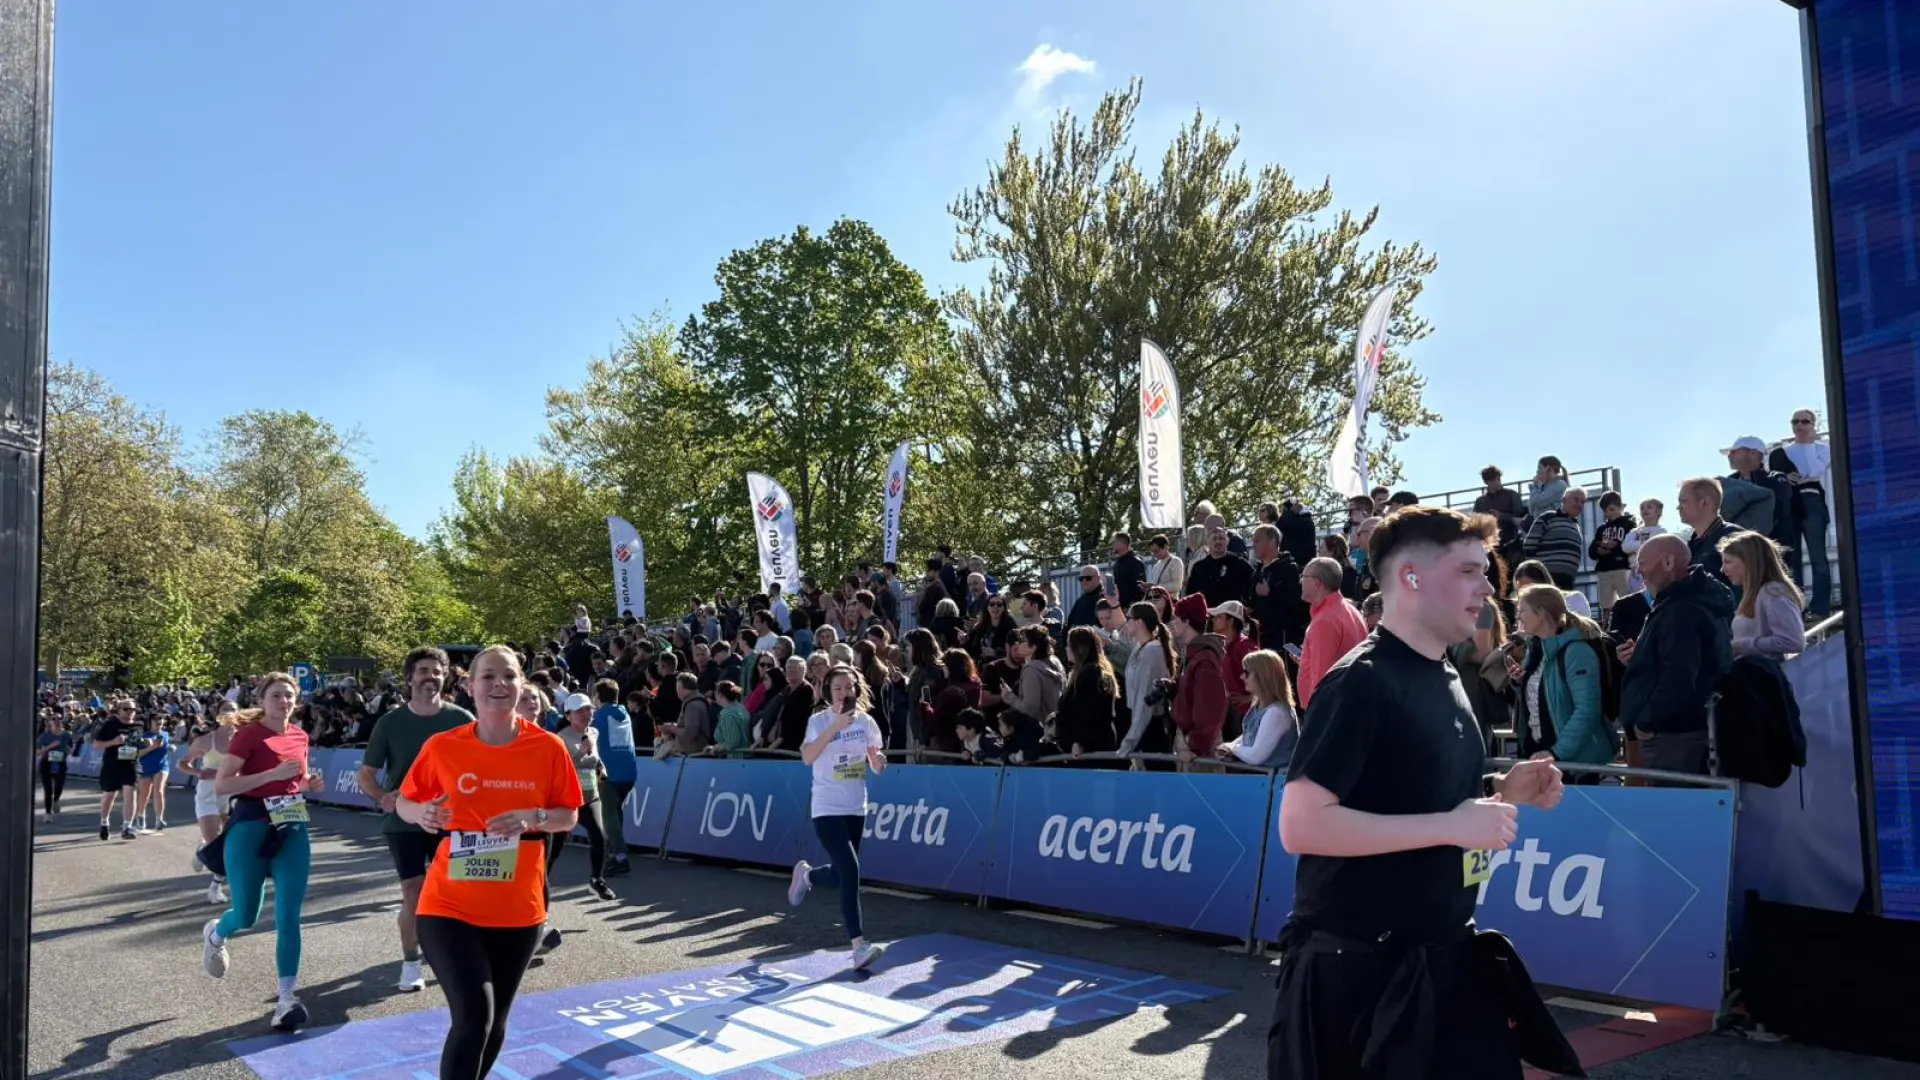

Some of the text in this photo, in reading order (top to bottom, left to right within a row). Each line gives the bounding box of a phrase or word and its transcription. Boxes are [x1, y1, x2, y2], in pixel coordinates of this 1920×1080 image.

[295, 666, 309, 684] P
[862, 798, 950, 846] certa
[1038, 813, 1196, 873] acerta
[464, 858, 500, 868] JOLIEN
[465, 868, 499, 877] 20283
[1476, 838, 1606, 919] rta
